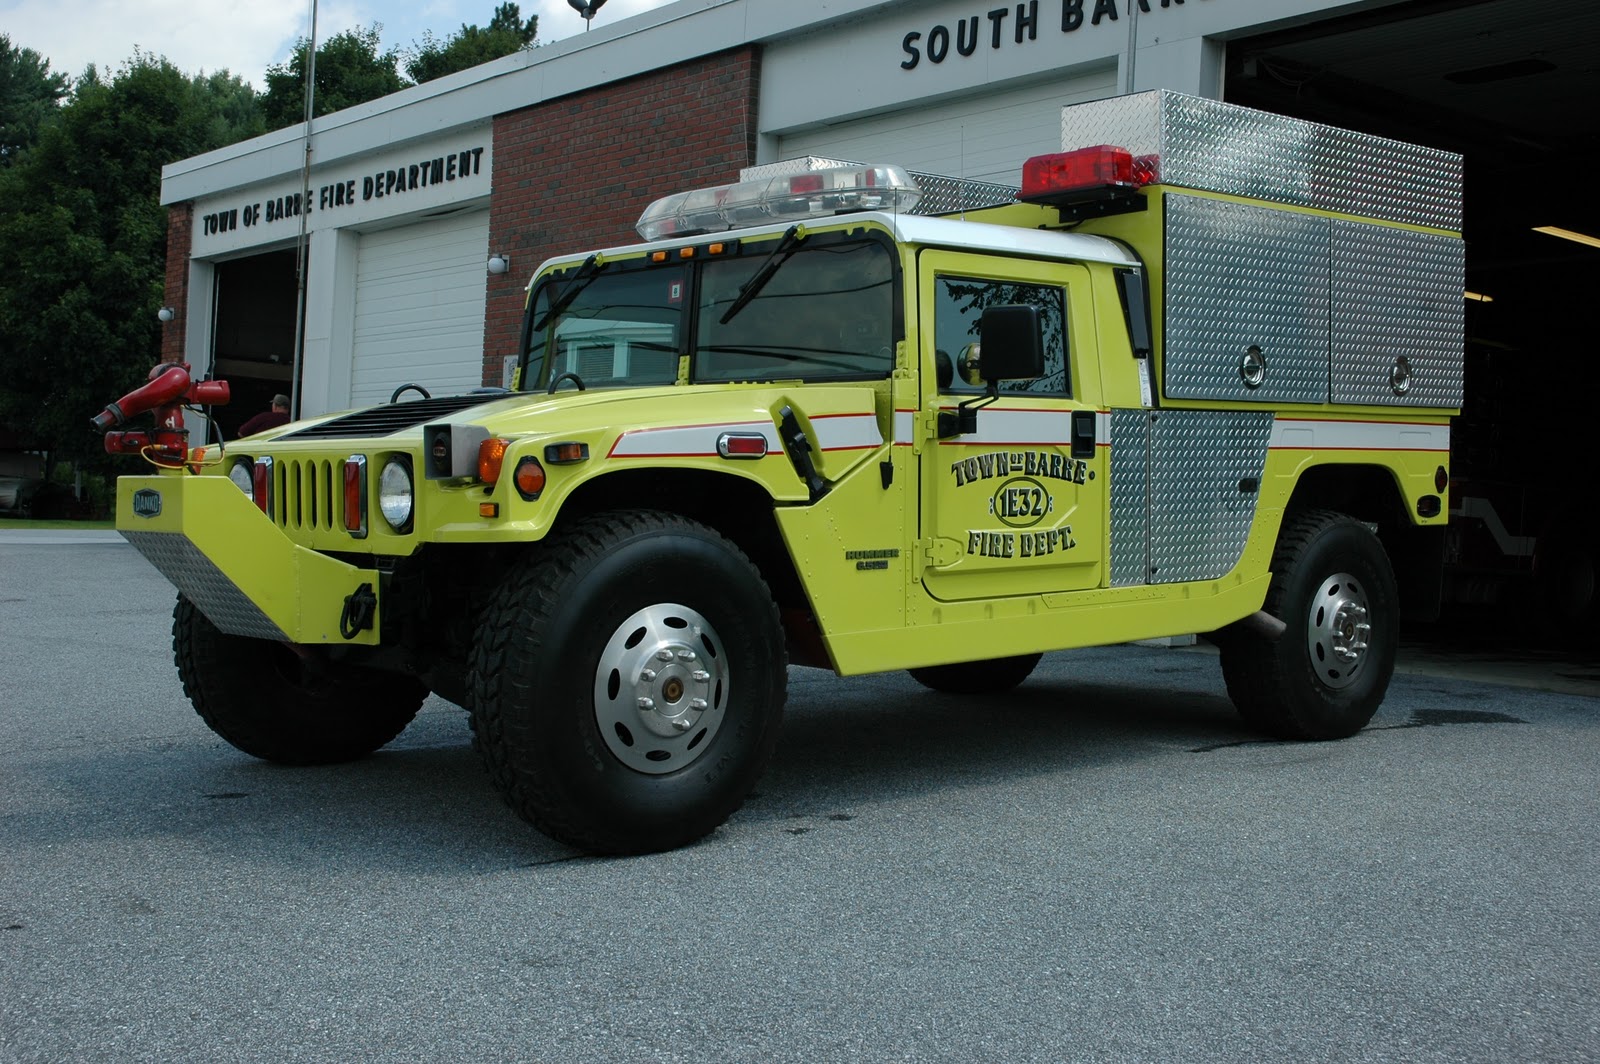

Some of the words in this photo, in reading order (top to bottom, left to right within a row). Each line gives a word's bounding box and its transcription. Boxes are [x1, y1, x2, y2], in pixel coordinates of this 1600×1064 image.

[900, 0, 1038, 70] SOUTH
[1061, 0, 1184, 33] BA
[203, 208, 237, 236] TOWN
[242, 203, 261, 228] OF
[320, 180, 356, 210] FIRE
[363, 147, 484, 201] DEPARTMENT
[951, 451, 1009, 487] TOWN
[1010, 453, 1024, 465] OF
[1023, 450, 1088, 486] BARRE
[135, 494, 159, 512] DANKO
[999, 487, 1042, 518] 1E32
[845, 548, 900, 560] HUMMER
[966, 530, 1015, 559] FIRE
[1019, 524, 1077, 558] DEPT.
